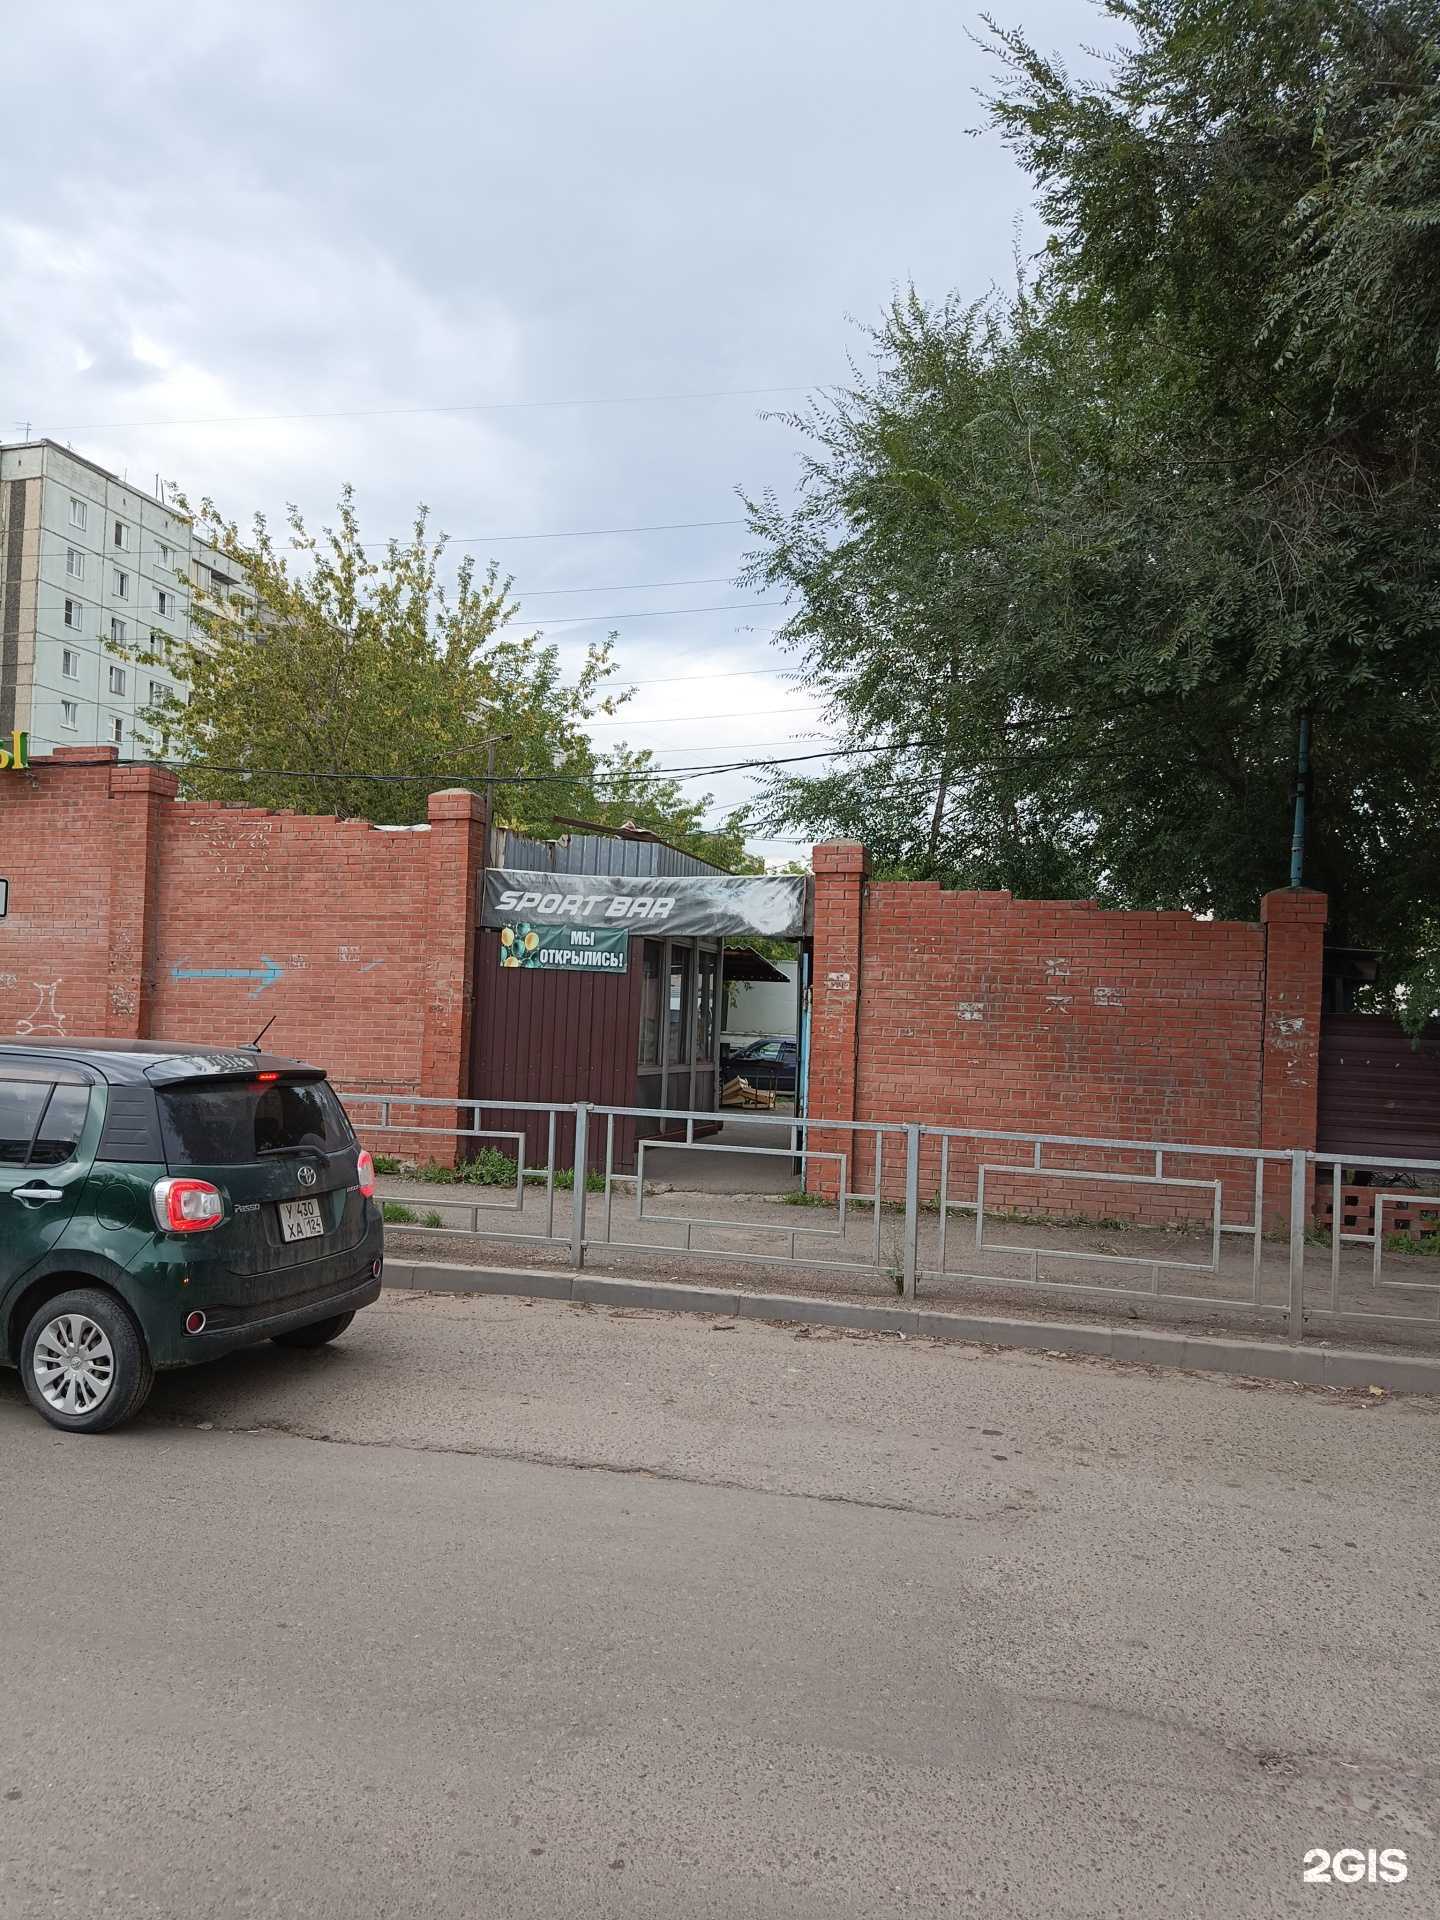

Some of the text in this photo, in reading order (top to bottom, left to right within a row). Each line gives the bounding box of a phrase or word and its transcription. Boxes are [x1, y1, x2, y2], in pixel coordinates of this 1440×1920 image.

[495, 890, 676, 919] SPORT BAR
[570, 930, 595, 946] МЫ
[539, 949, 624, 968] ОТКРЫЛИСЬ!
[297, 1202, 314, 1217] 430
[306, 1218, 321, 1231] 124
